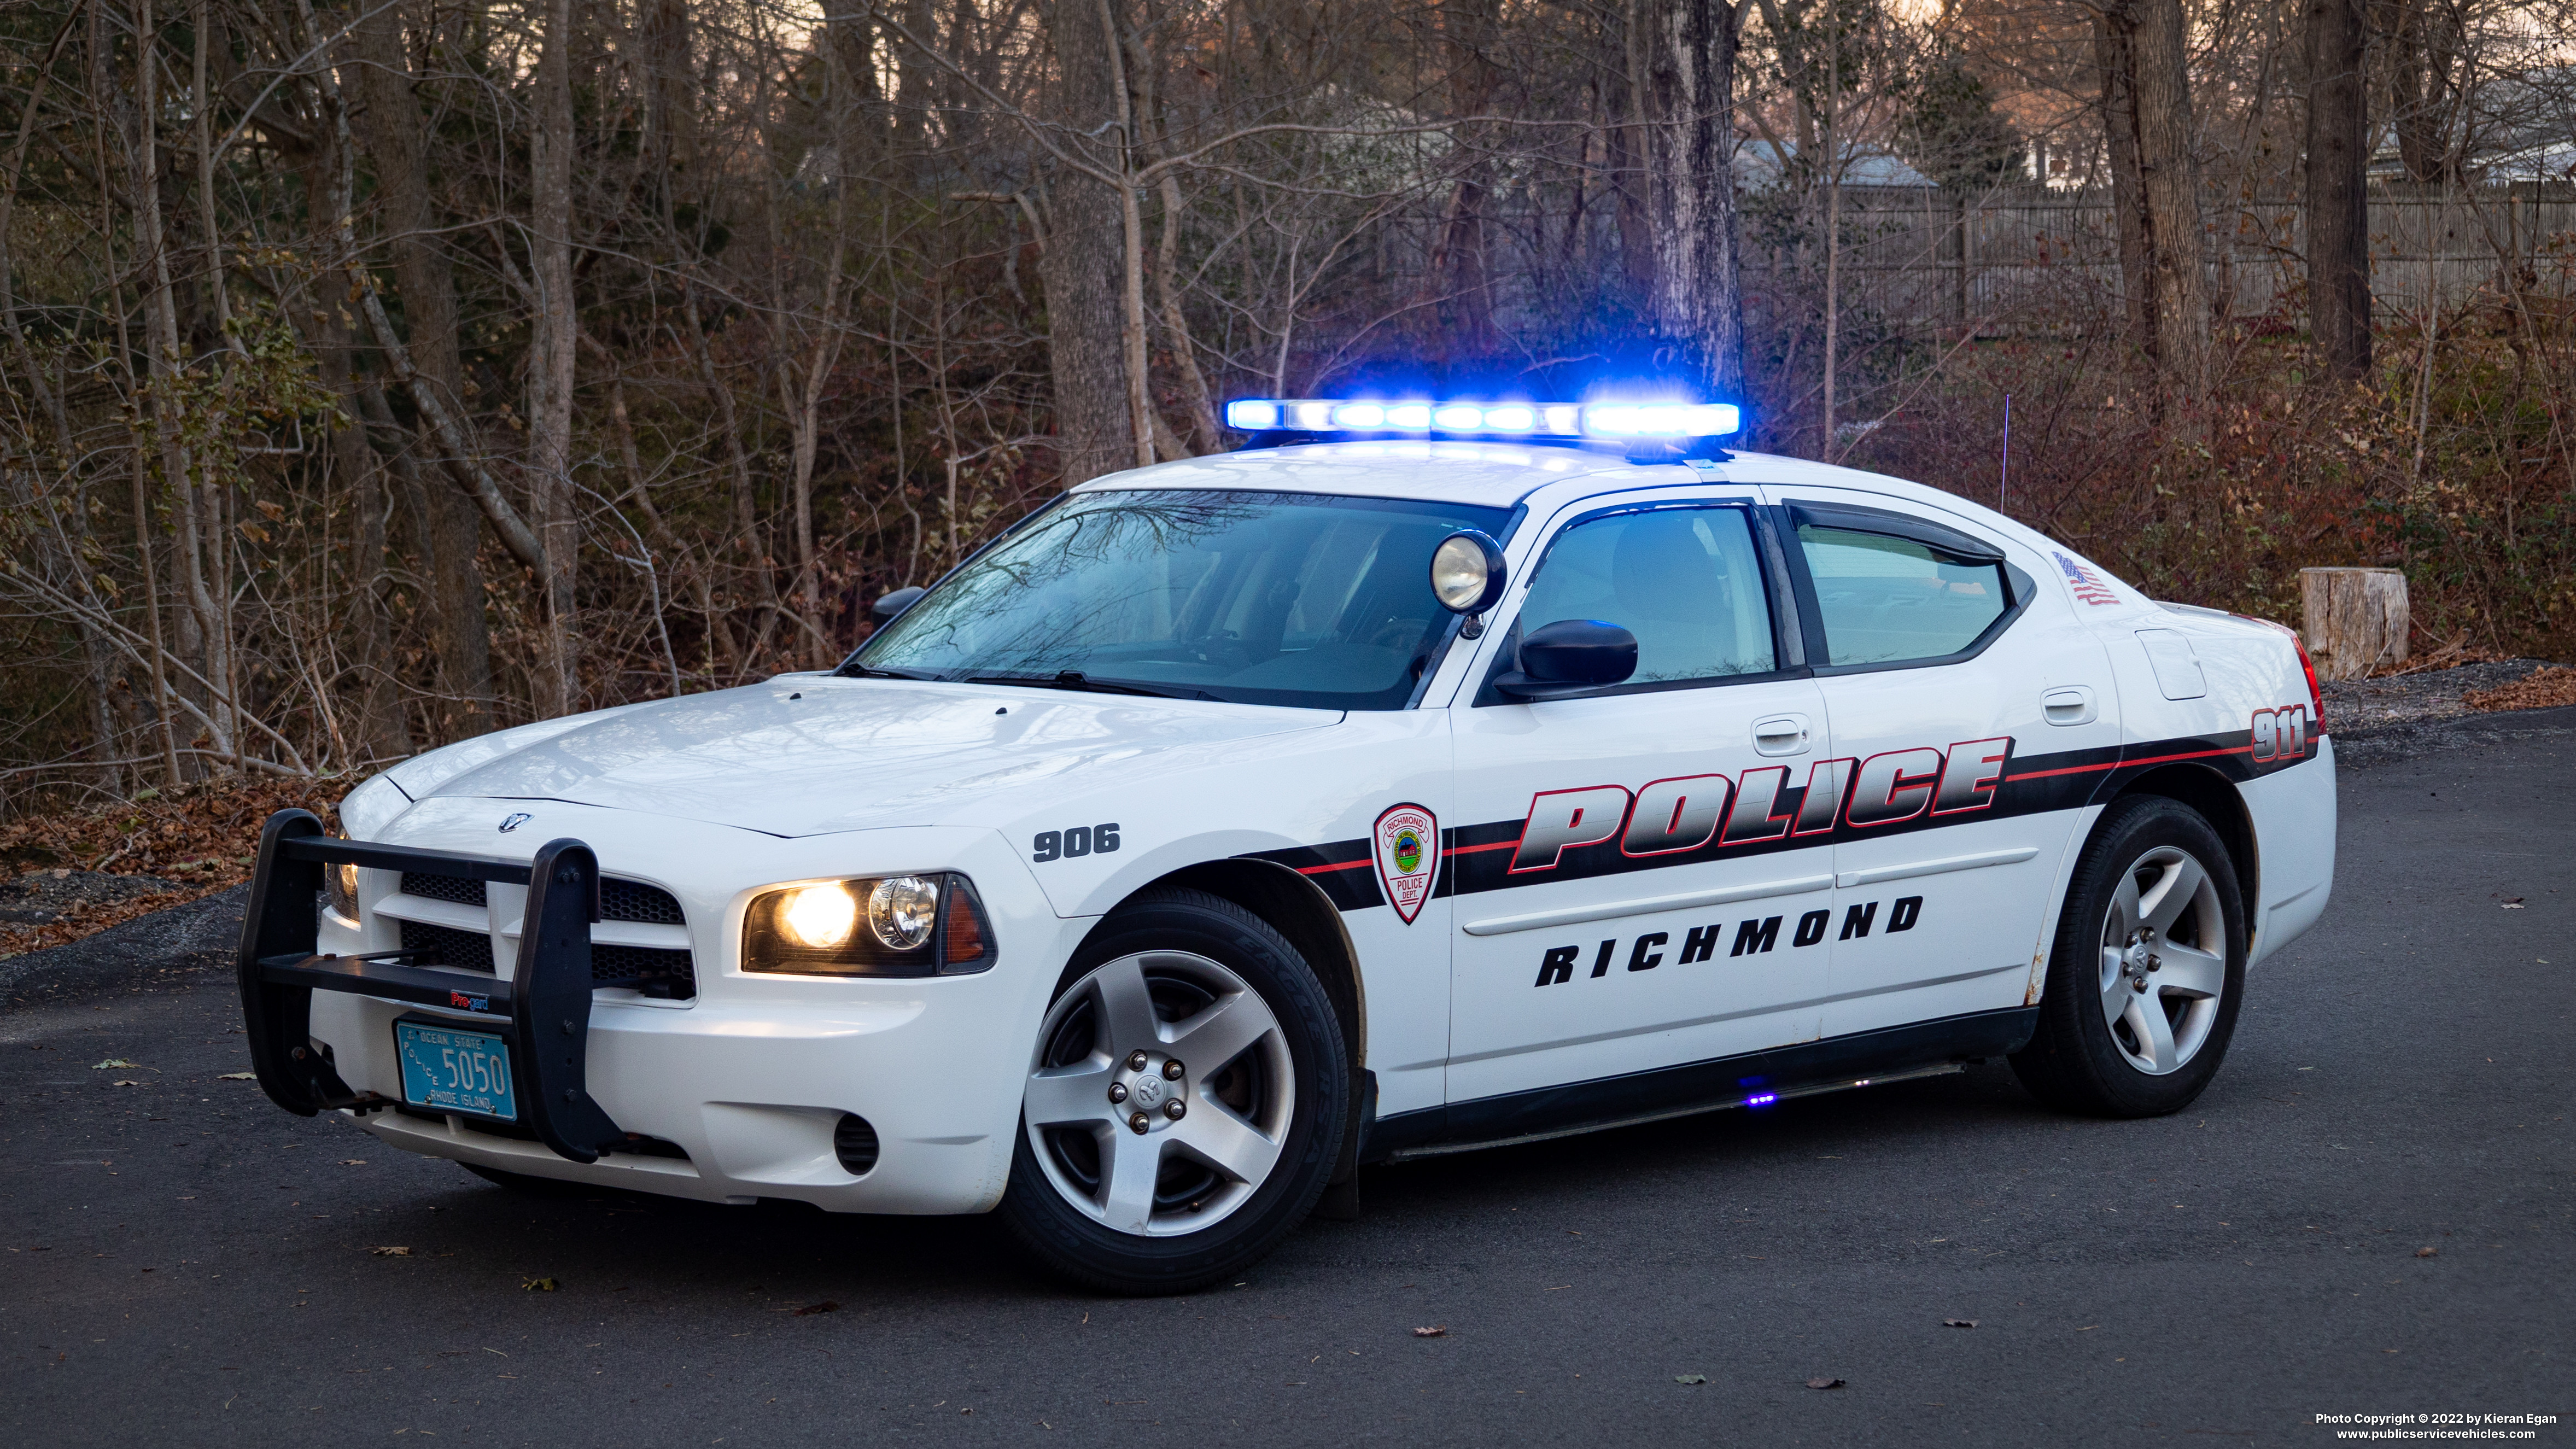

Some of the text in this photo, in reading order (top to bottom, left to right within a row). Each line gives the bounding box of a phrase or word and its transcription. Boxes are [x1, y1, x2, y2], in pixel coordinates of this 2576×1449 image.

[2251, 703, 2306, 763] 911
[1387, 816, 1424, 832] RICHMOND
[1508, 736, 2016, 874] POLICE
[1033, 822, 1120, 863] 906
[1397, 877, 1423, 891] POLICE
[1402, 890, 1418, 899] DEPT.
[1534, 895, 1924, 988] RICHMOND
[1232, 934, 1325, 1044] EAGLE
[420, 1031, 482, 1050] OCEAN STATE
[404, 1041, 439, 1086] POLICE
[442, 1048, 505, 1096] 5050
[430, 1089, 490, 1109] RHODE ISLAND
